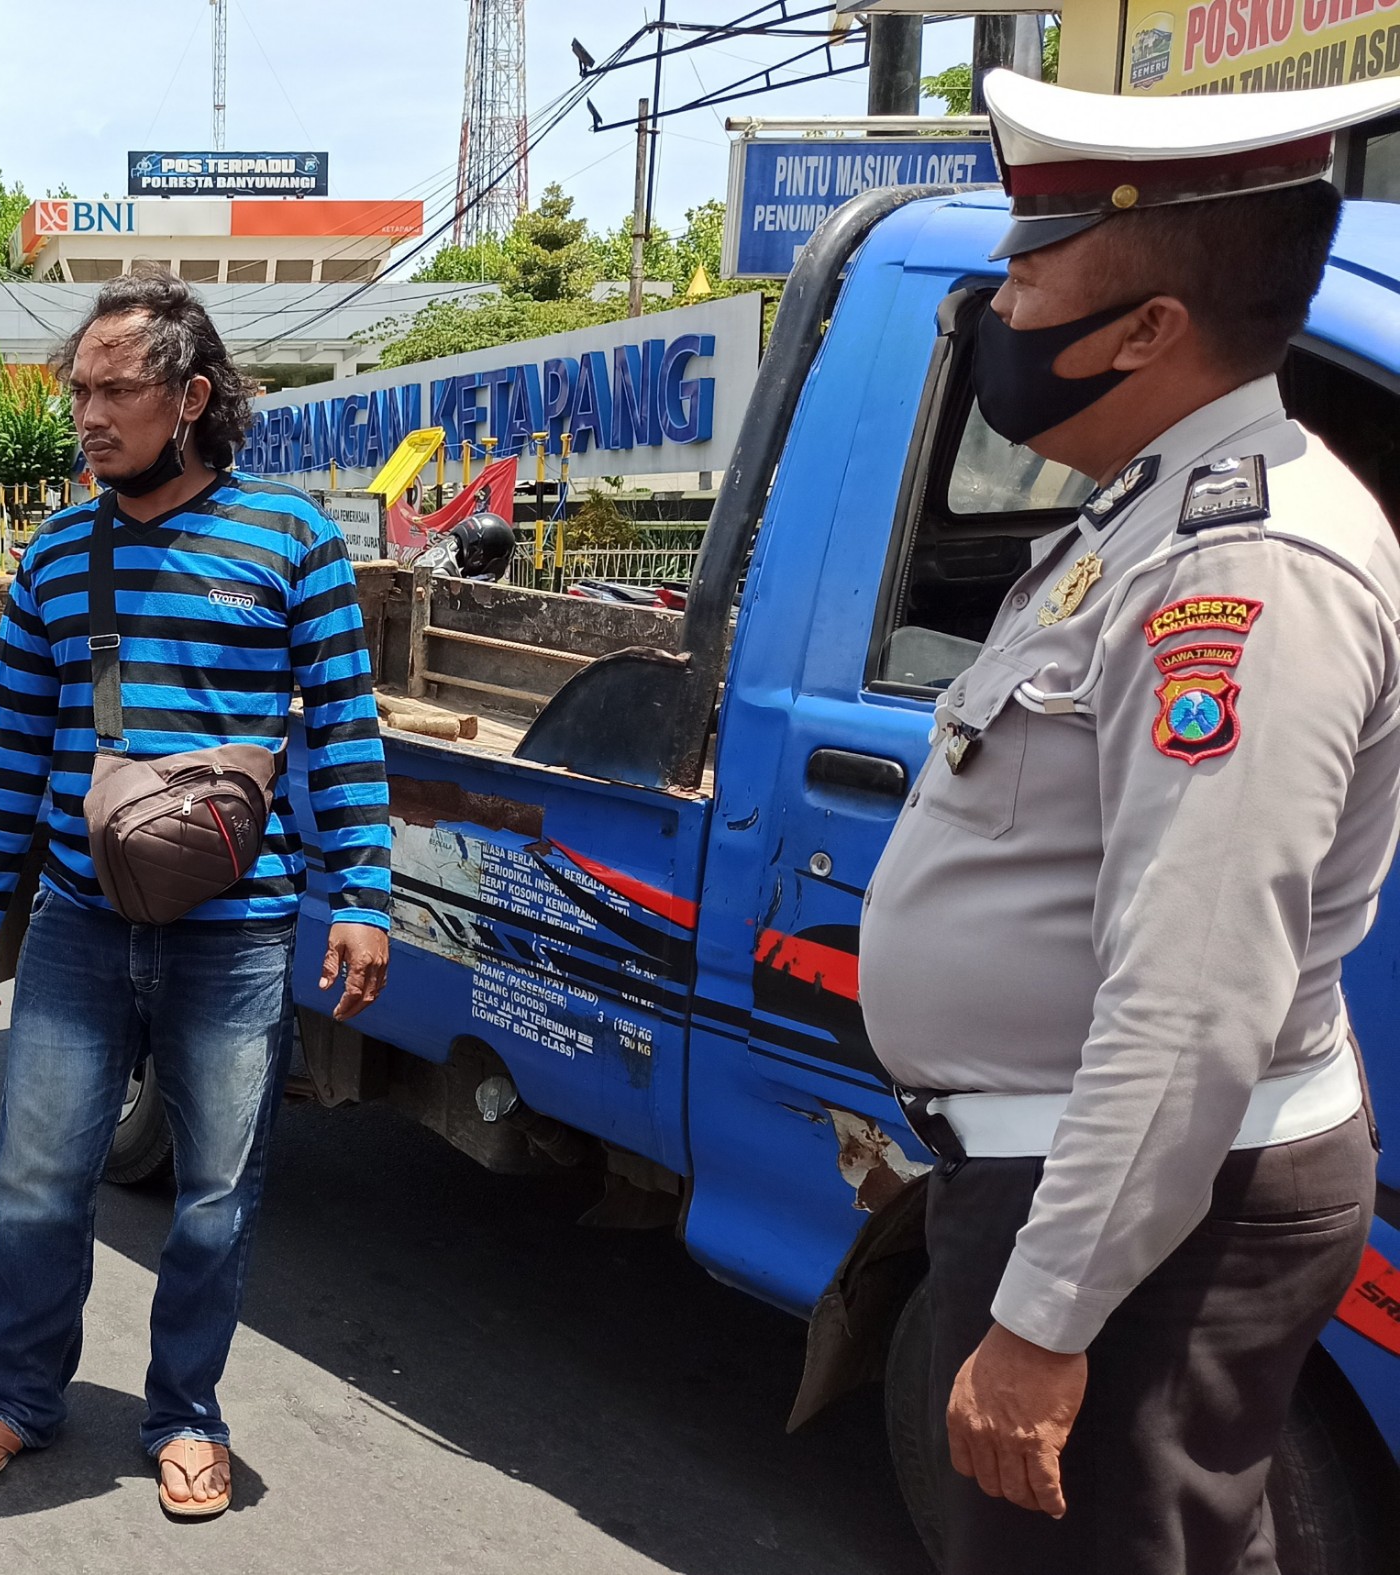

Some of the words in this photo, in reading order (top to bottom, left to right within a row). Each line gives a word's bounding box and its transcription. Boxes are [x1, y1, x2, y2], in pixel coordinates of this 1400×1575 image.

[1184, 0, 1295, 72] POSKO
[1132, 60, 1168, 79] SEMERU
[1239, 40, 1347, 94] TANGGUH
[161, 158, 203, 173] POS
[206, 158, 296, 173] TERPADU
[774, 155, 831, 197] PINTU
[835, 155, 902, 197] MASUK
[141, 176, 214, 188] POLRESTA
[216, 176, 316, 189] BANYUWANGI
[73, 201, 135, 233] BNI
[430, 333, 716, 462] KETAPANG
[212, 592, 252, 607] VOLVO
[1152, 601, 1247, 630] POLRESTA
[1161, 651, 1195, 667] JAWA
[1195, 648, 1233, 662] TIMUR
[482, 843, 505, 859] MASA
[481, 860, 533, 886] (PERIODIKAL
[564, 868, 605, 892] BERKALA
[480, 874, 506, 891] BERAT
[508, 883, 543, 904] KOSONG
[545, 895, 598, 925] KENDARAAN
[480, 892, 509, 909] (EMPTY
[510, 902, 546, 922] VEHICLE
[472, 988, 499, 1007] KELAS
[500, 1001, 528, 1019] JALAN
[529, 1011, 576, 1040] TERENDAH
[472, 974, 508, 998] BARANG
[510, 991, 547, 1016] (GOODS)
[619, 1034, 635, 1049] 790
[637, 1042, 651, 1056] KG
[474, 962, 505, 982] ORANG
[507, 974, 567, 1009] (PASSENGER)
[597, 1010, 604, 1022] 3
[613, 1017, 637, 1038] (180)
[638, 1027, 652, 1042] KG
[472, 1005, 511, 1030] (LOWEST
[541, 1035, 575, 1060] CLASS)
